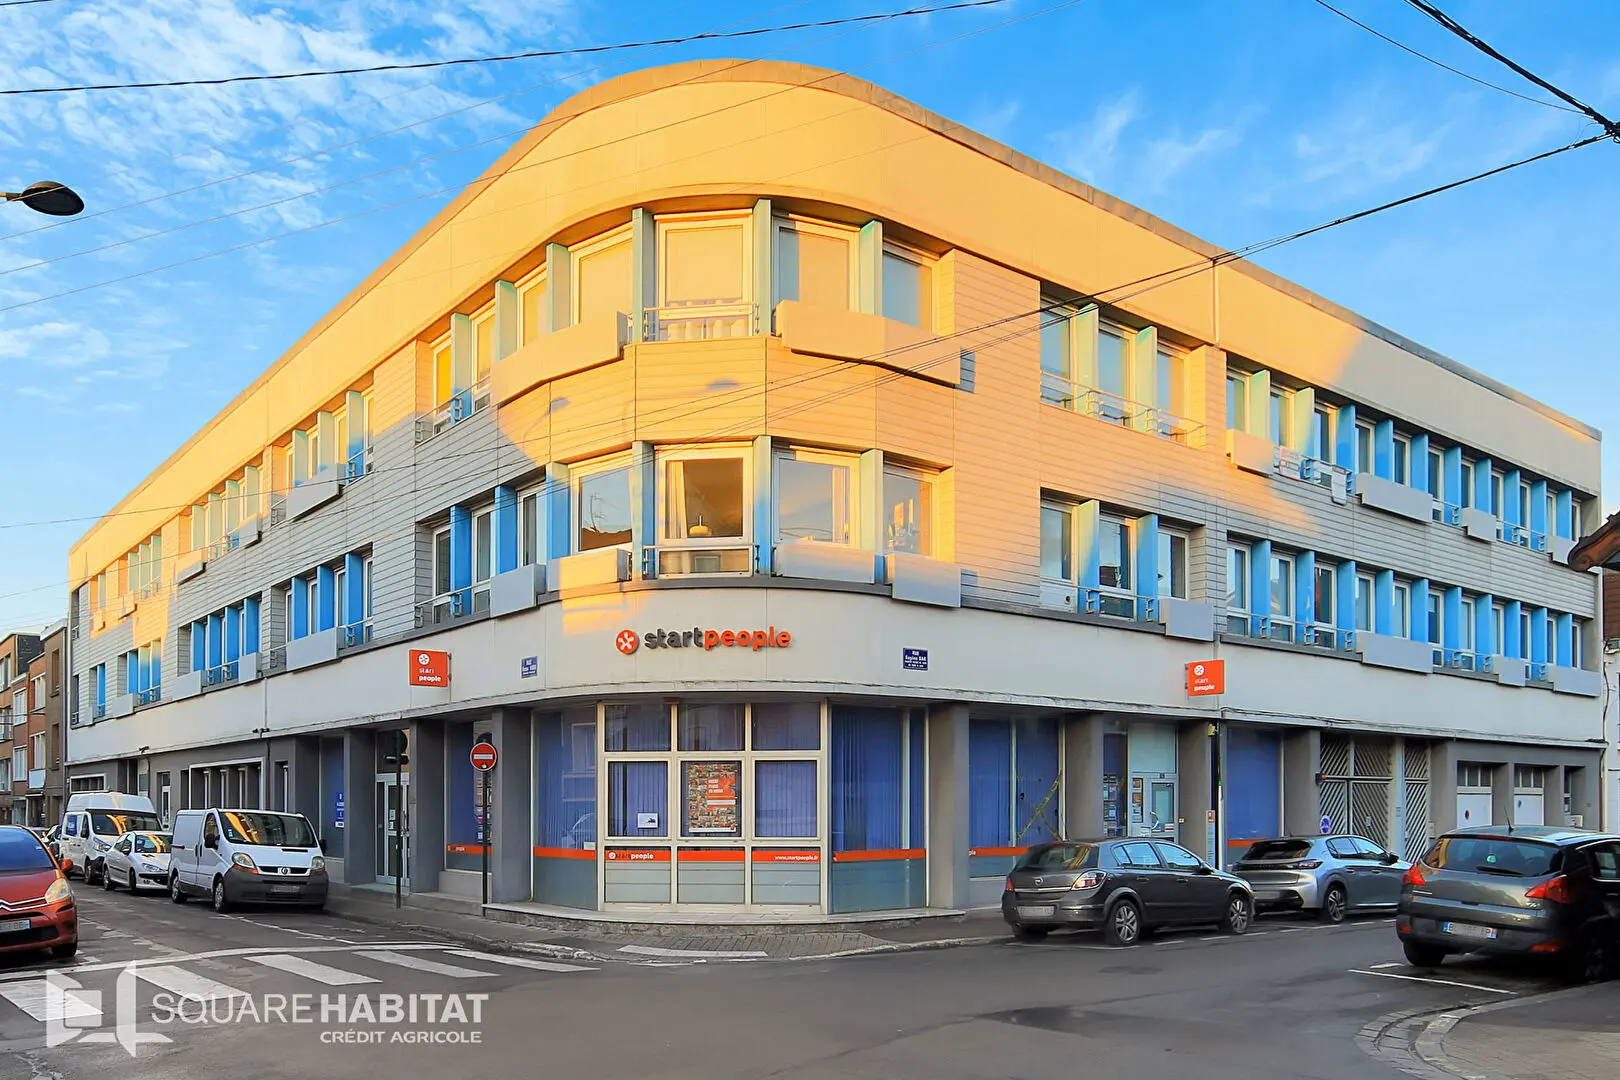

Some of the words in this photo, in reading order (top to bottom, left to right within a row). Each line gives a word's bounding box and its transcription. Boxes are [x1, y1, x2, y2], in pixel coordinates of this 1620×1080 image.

[644, 626, 792, 652] startpeople
[418, 674, 442, 683] people
[1193, 684, 1215, 692] people
